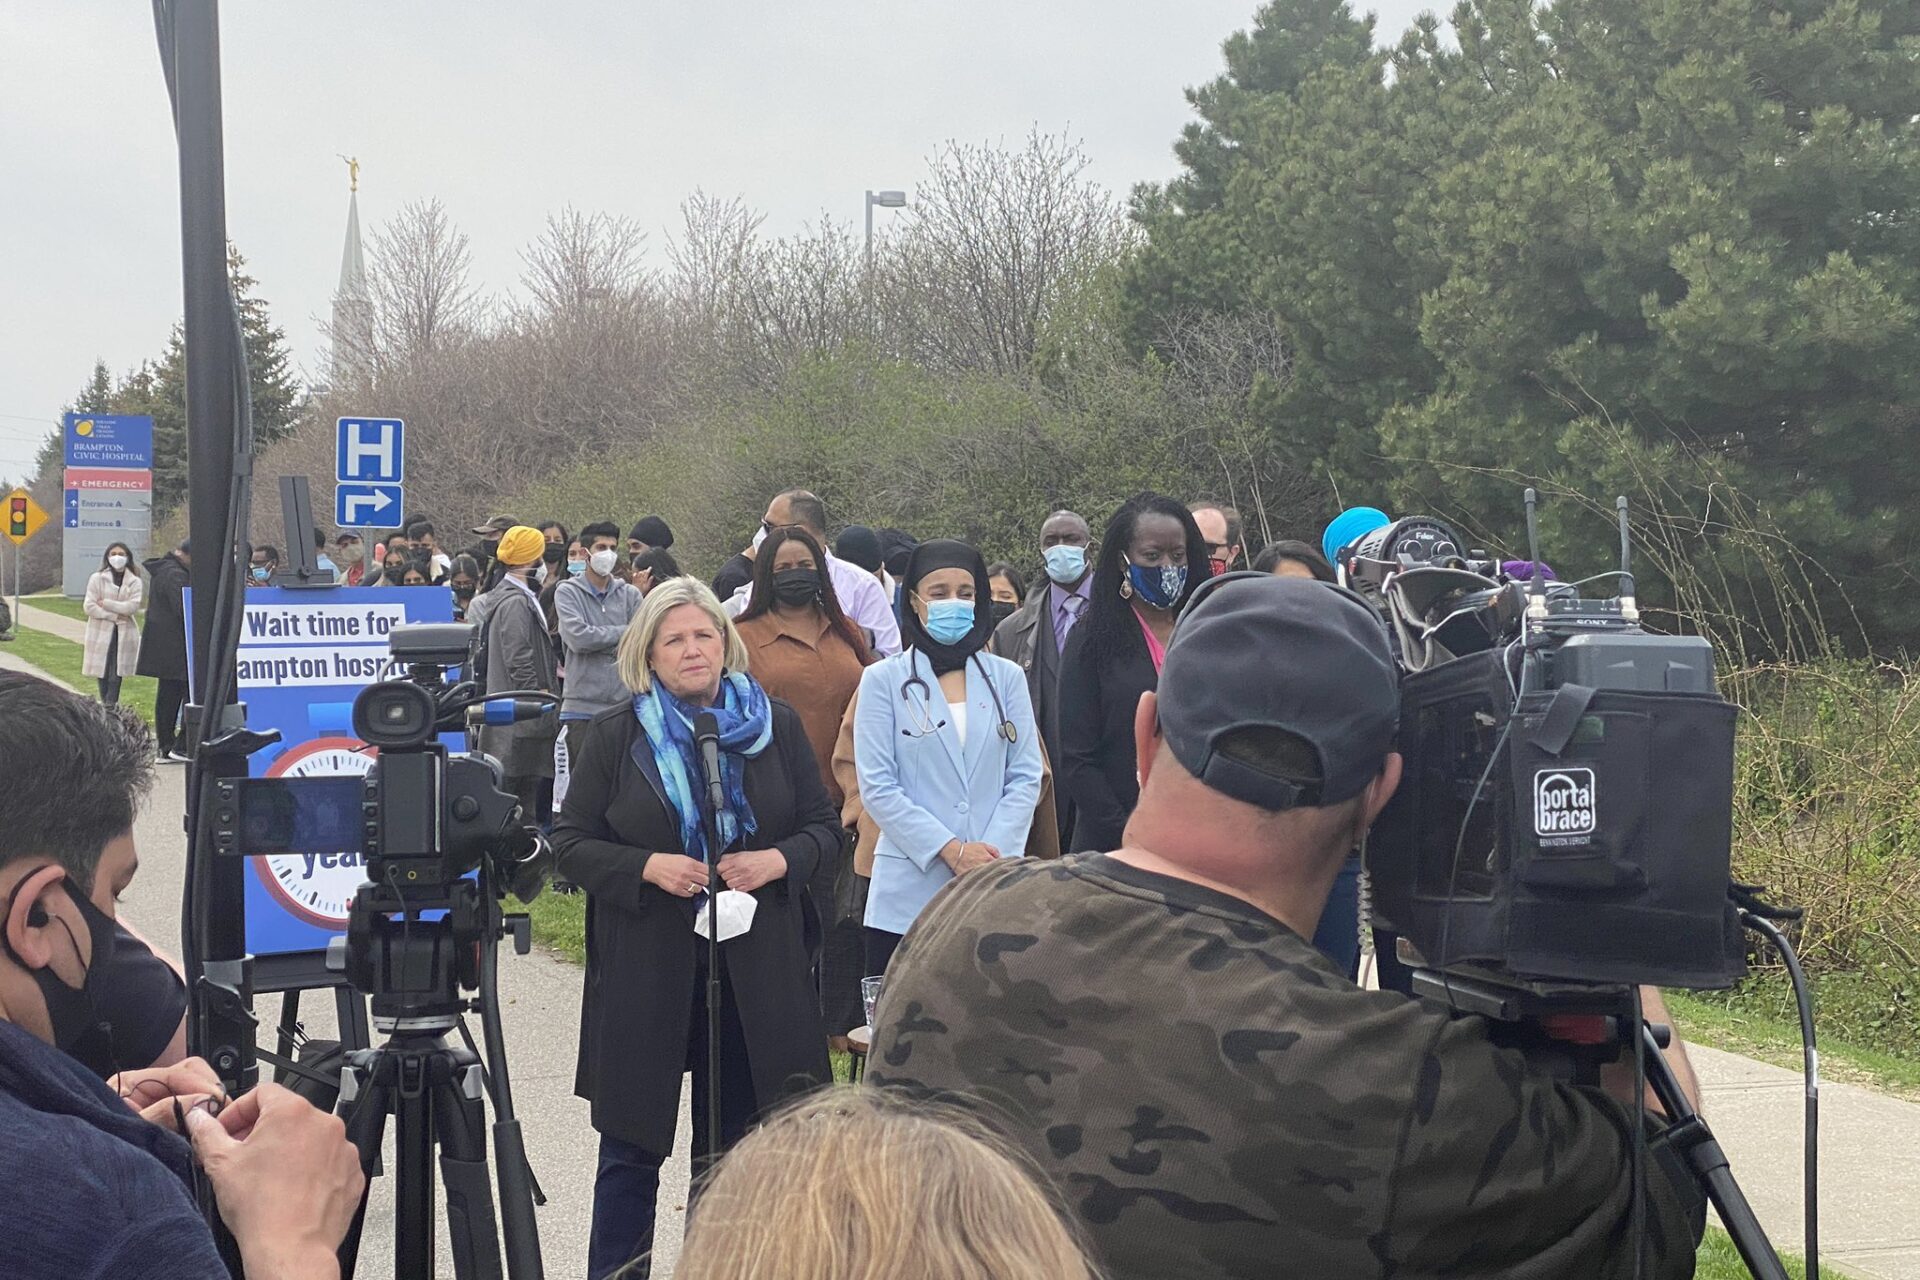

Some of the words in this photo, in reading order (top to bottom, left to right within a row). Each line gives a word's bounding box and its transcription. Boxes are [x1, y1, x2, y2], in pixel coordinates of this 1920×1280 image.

[73, 443, 124, 452] BRAMPTON
[73, 452, 100, 460] CIVIC
[101, 452, 144, 461] HOSPITAL
[346, 424, 394, 478] H
[81, 480, 144, 488] EMERGENCY
[81, 500, 113, 508] Entrance
[115, 500, 122, 508] A
[81, 519, 113, 527] Entrance
[115, 519, 121, 527] B
[246, 611, 301, 637] Wait
[306, 611, 360, 636] time
[365, 610, 399, 636] for
[237, 656, 328, 686] ampton
[1540, 780, 1590, 810] porta
[1540, 809, 1591, 831] brace
[302, 852, 368, 880] yea
